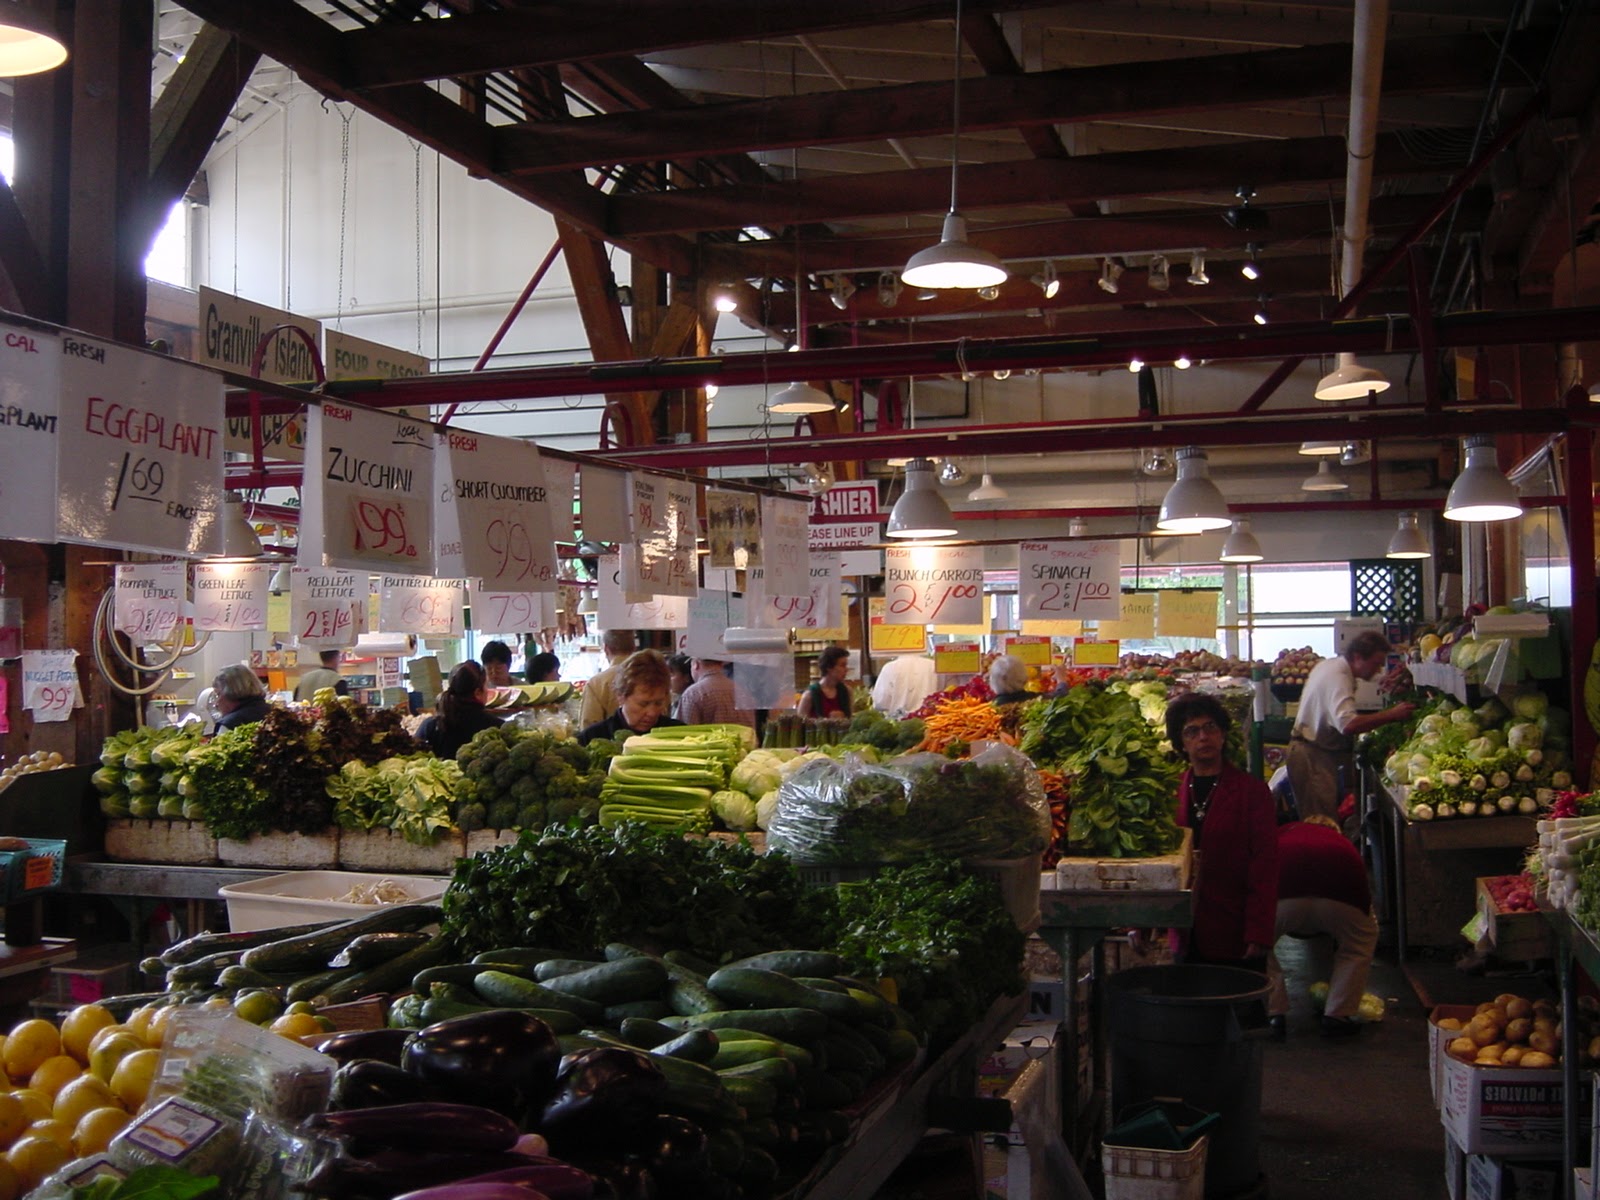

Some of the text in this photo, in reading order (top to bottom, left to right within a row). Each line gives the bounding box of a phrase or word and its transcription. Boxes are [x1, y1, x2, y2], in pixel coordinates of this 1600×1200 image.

[63, 337, 105, 364] FRESH
[335, 348, 369, 372] FOUR
[323, 404, 352, 421] FRESH
[85, 397, 219, 460] EGGPLANT
[449, 433, 478, 452] FRESH
[327, 447, 413, 493] ZUCCHINI
[455, 478, 489, 500] SHORT
[491, 482, 548, 503] CUCUMBER
[808, 490, 872, 516] SHIER
[834, 527, 857, 538] LINE
[860, 526, 874, 537] UP
[887, 549, 911, 558] FRESH
[1021, 542, 1048, 551] FRESH
[889, 568, 983, 582] BUNCH CARROTS
[1032, 564, 1091, 580] SPINACH
[198, 579, 247, 589] GREEN LEAF
[307, 576, 356, 587] RED LEAF
[383, 576, 462, 589] BUTTER LETTUCE
[143, 588, 177, 599] LETTUCE
[220, 590, 253, 600] LETTUCE
[311, 588, 356, 598] LETTUCE
[890, 584, 923, 614] 2
[1040, 582, 1062, 611] 2
[123, 608, 145, 634] 2
[303, 610, 321, 638] 2
[1485, 1086, 1545, 1101] POTATOES
